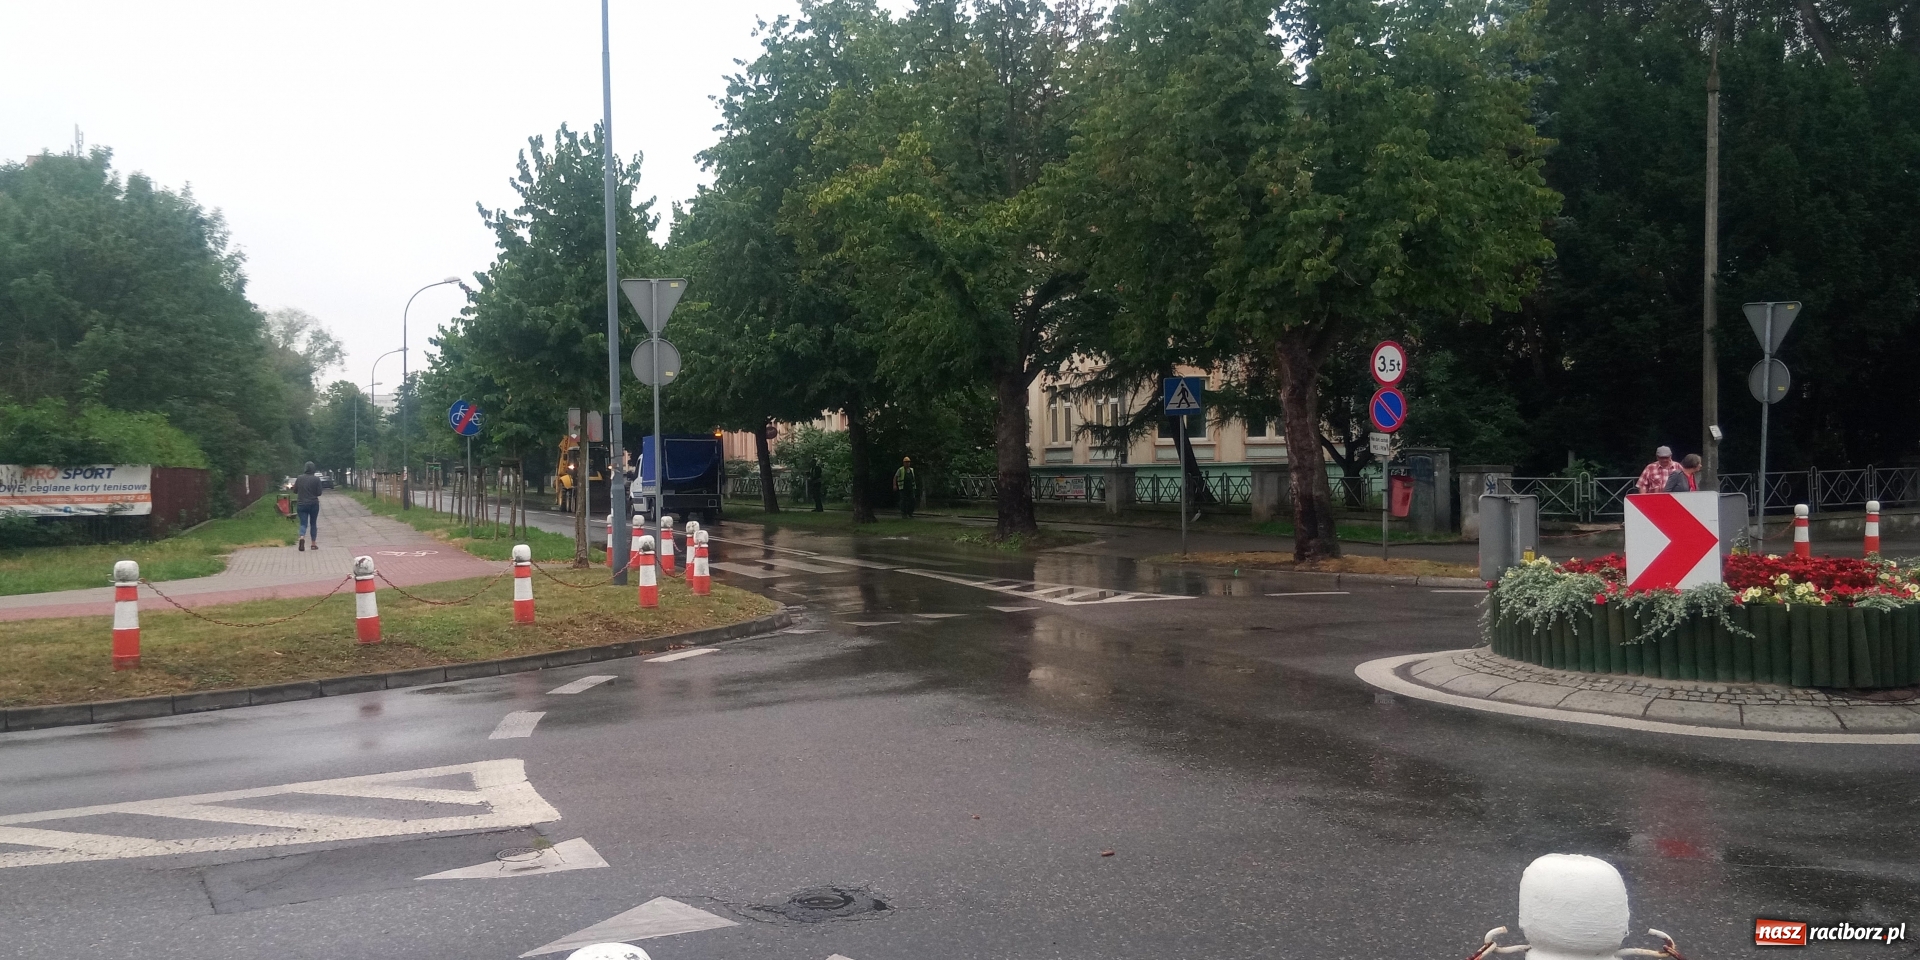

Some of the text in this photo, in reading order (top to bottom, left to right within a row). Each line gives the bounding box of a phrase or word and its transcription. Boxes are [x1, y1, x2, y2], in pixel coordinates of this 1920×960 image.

[1378, 355, 1401, 373] 3,5t
[22, 467, 116, 480] PRO SPORT
[30, 484, 71, 494] ceglane
[73, 483, 101, 494] korty
[103, 483, 148, 492] tenisowe
